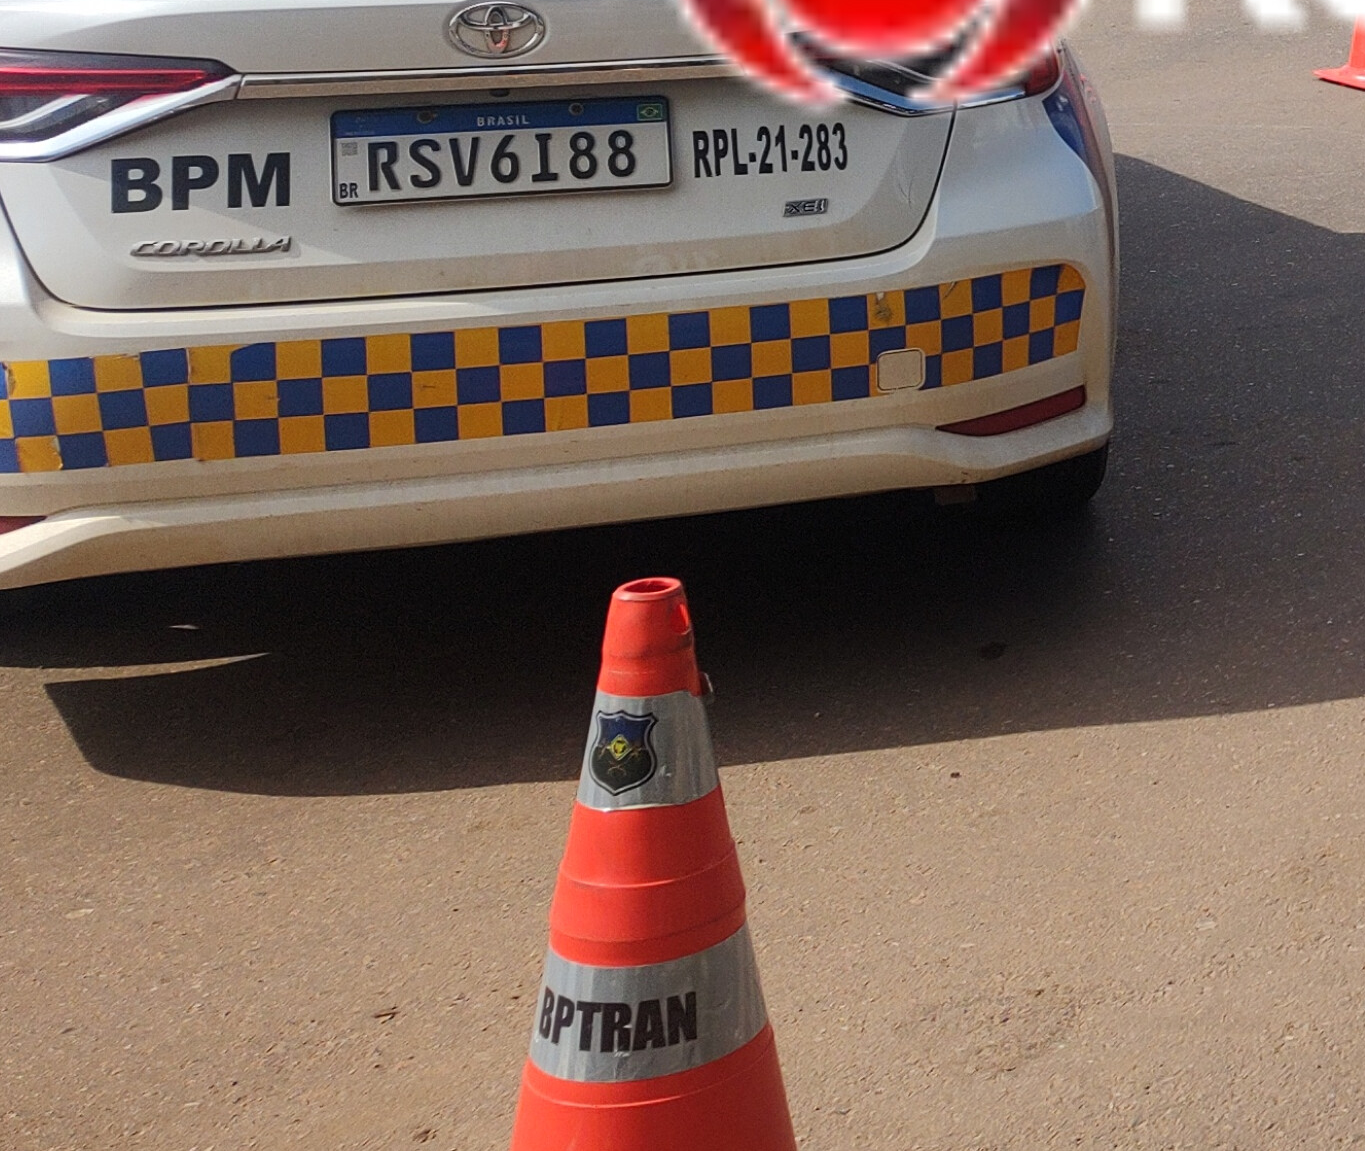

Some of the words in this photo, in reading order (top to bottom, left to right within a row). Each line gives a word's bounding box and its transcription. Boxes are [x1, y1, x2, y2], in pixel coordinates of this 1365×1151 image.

[476, 114, 531, 128] BRASIL
[367, 129, 637, 192] RSV6I88
[692, 122, 848, 178] RPL-21-283
[111, 152, 291, 214] BPM
[339, 182, 360, 199] BR
[130, 235, 293, 257] COROLLA
[539, 985, 698, 1054] BPTRAN
